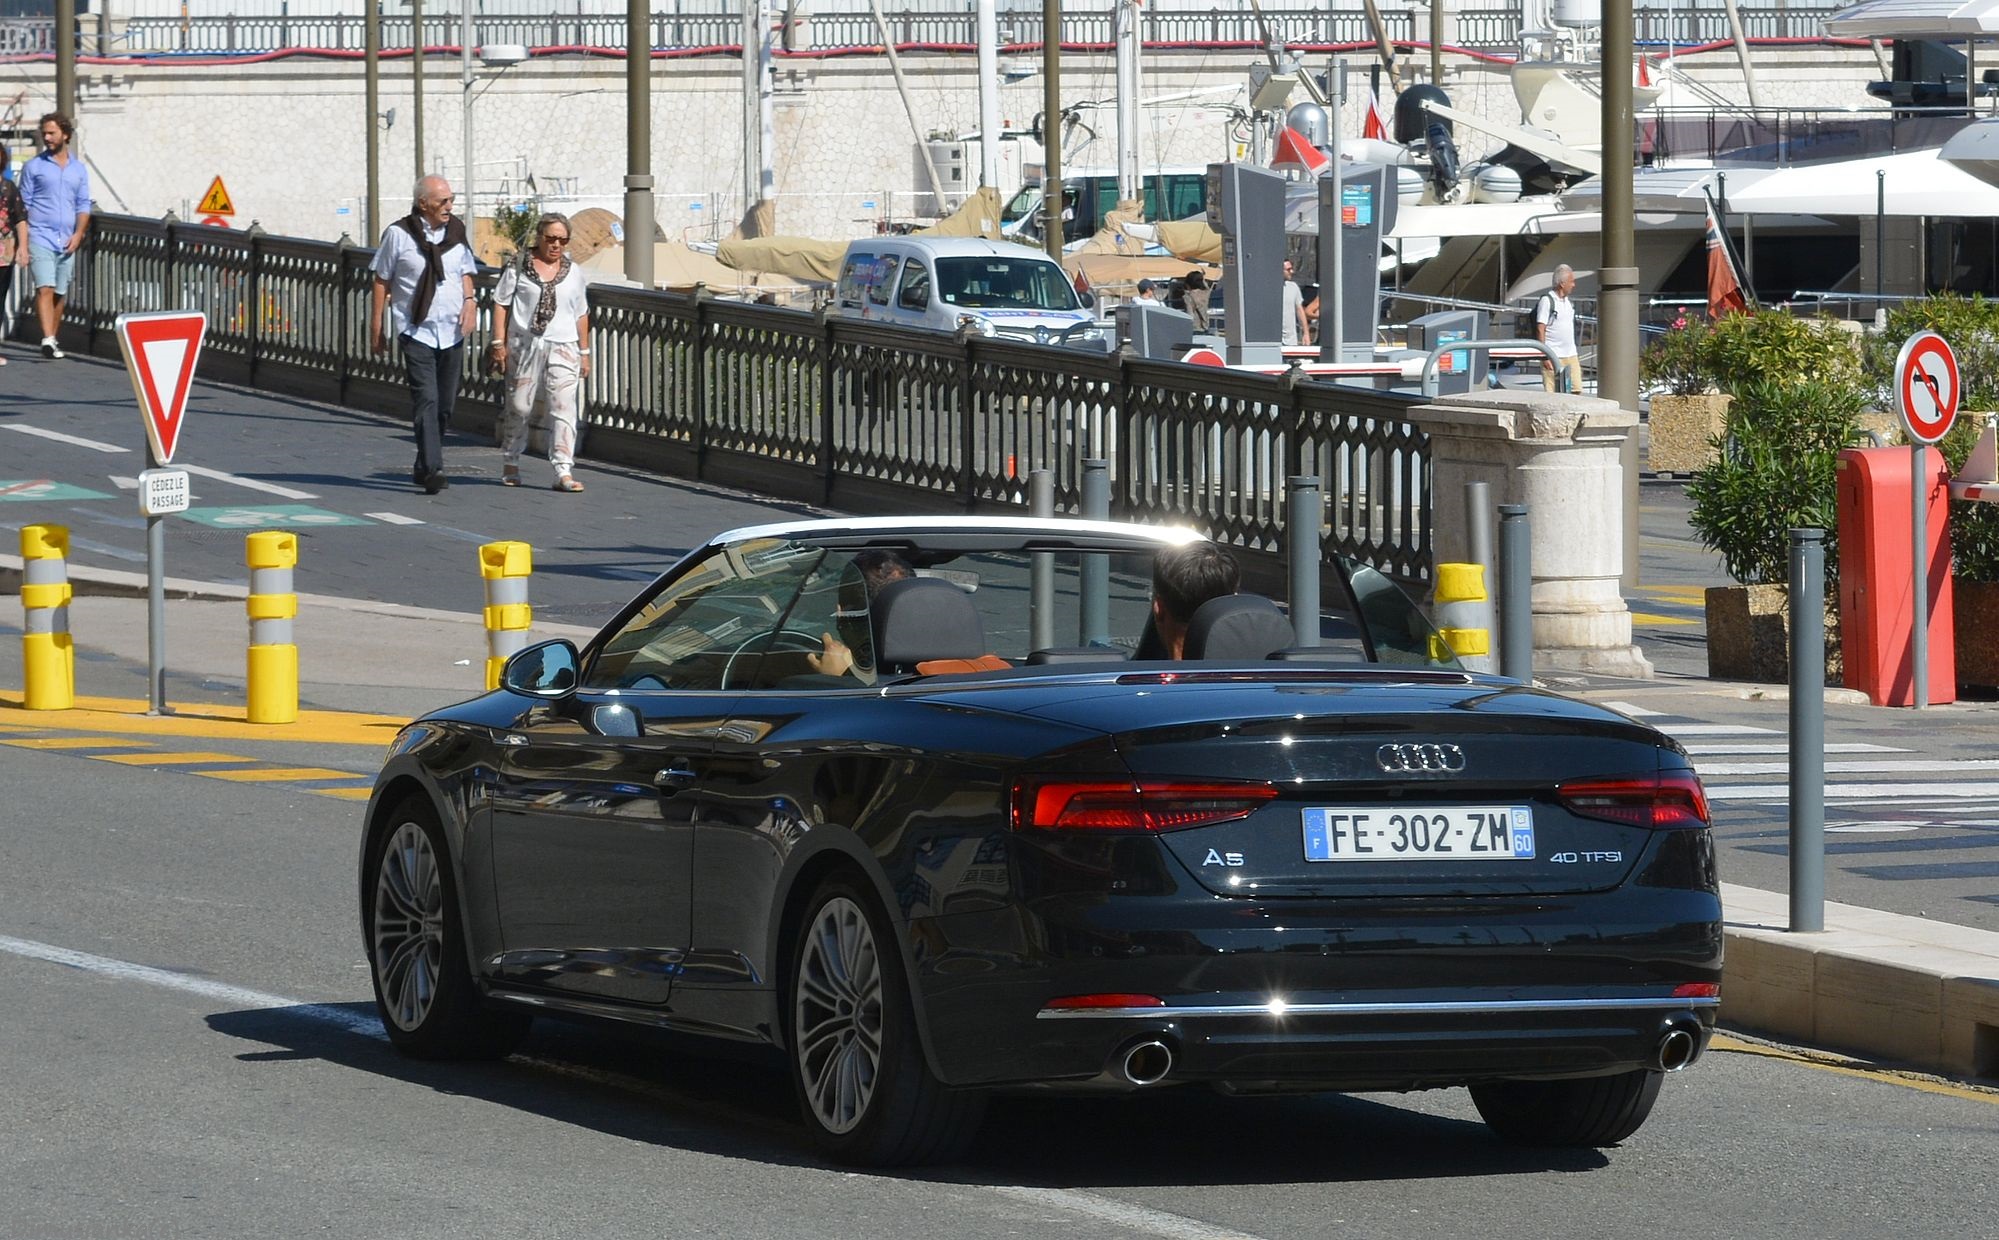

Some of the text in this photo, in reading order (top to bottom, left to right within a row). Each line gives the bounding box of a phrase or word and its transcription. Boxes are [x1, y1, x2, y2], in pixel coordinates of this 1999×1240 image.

[175, 477, 183, 489] LE
[152, 494, 183, 508] PASSAGE
[1331, 813, 1510, 853] FE-302-ZM
[1313, 838, 1321, 849] F
[1514, 834, 1532, 852] 60
[1202, 848, 1244, 867] A5
[1550, 851, 1622, 863] 40 TFSI
